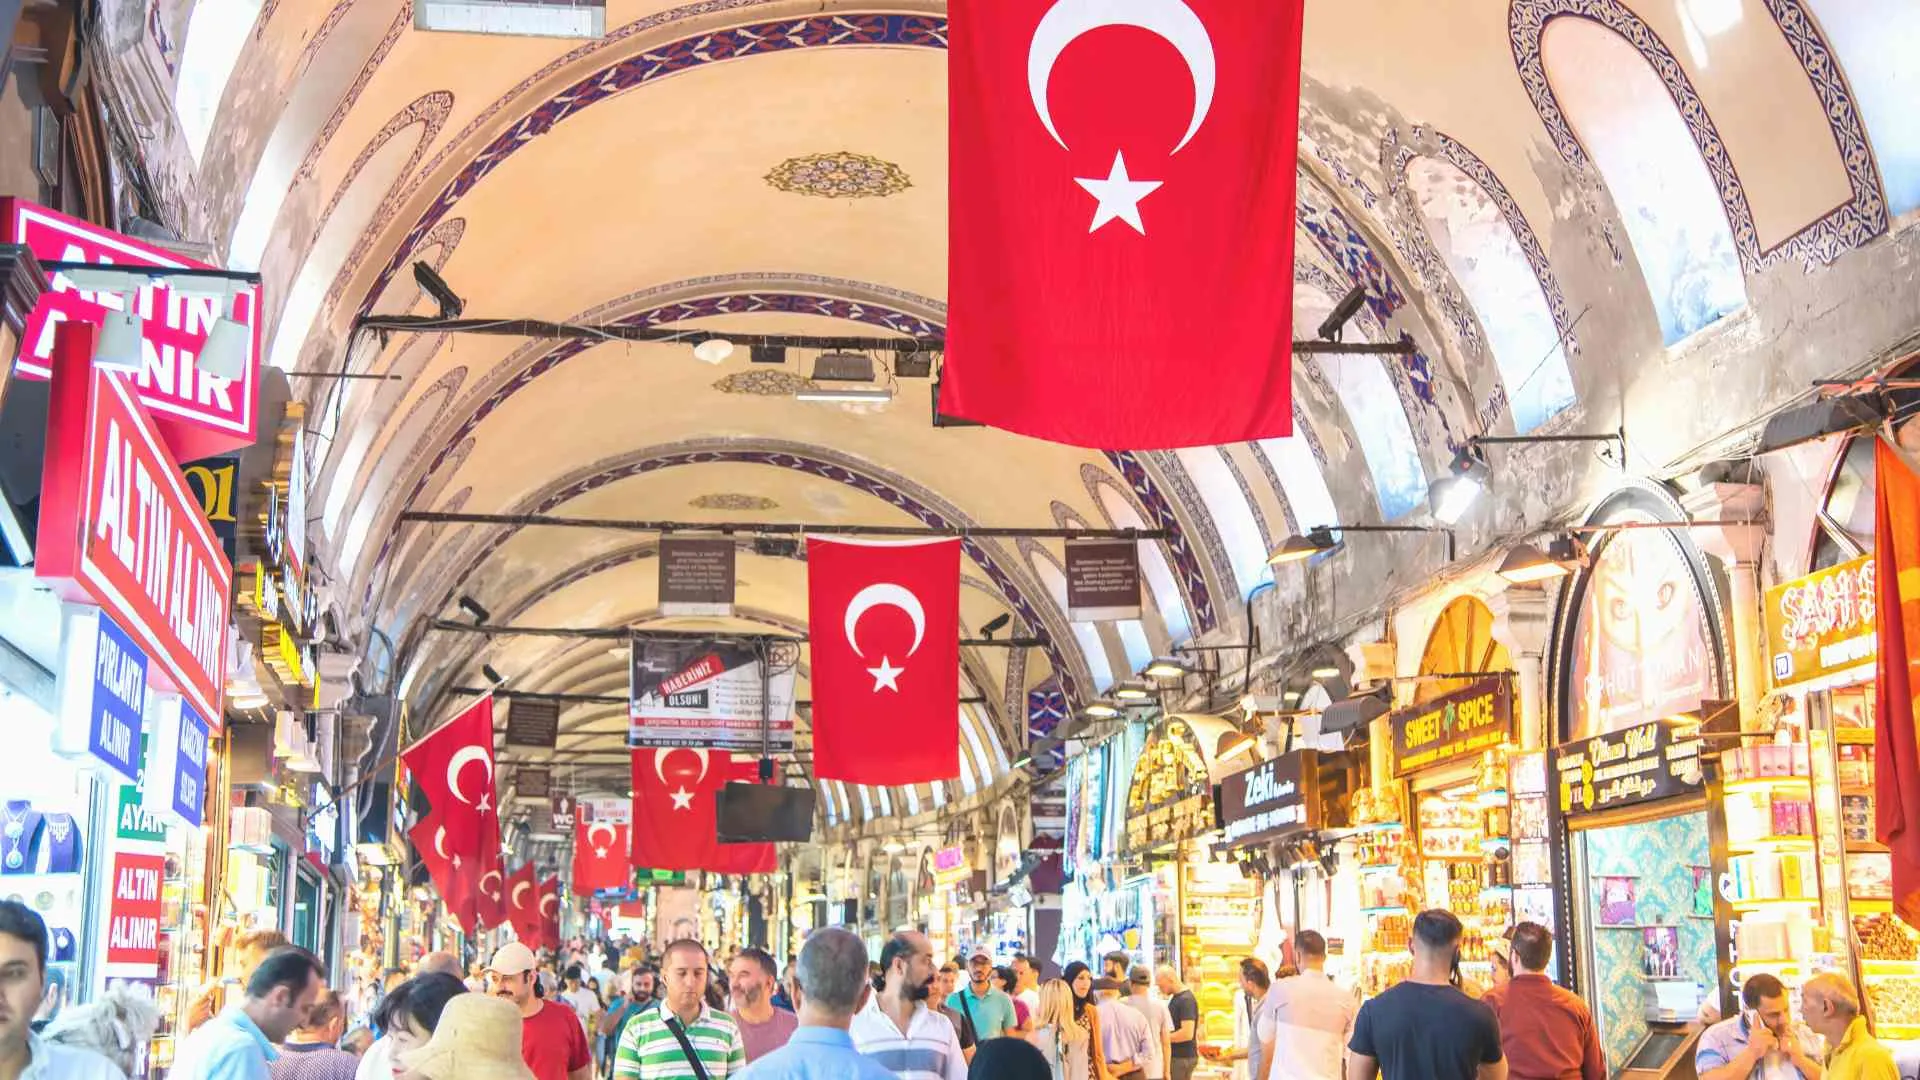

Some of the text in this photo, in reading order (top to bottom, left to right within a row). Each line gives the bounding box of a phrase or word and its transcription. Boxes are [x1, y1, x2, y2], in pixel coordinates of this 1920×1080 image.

[34, 308, 234, 413] ANIR
[97, 417, 223, 690] ALTIN ALINIR
[97, 630, 143, 716] PIRLANTA
[668, 693, 703, 706] OLSUN!
[1405, 693, 1495, 749] SWEET SPICE
[100, 708, 132, 766] ALINIR
[1244, 761, 1275, 808] Zeki
[552, 813, 574, 825] WC
[116, 867, 159, 901] ALTIN
[110, 916, 158, 950] ALINIR
